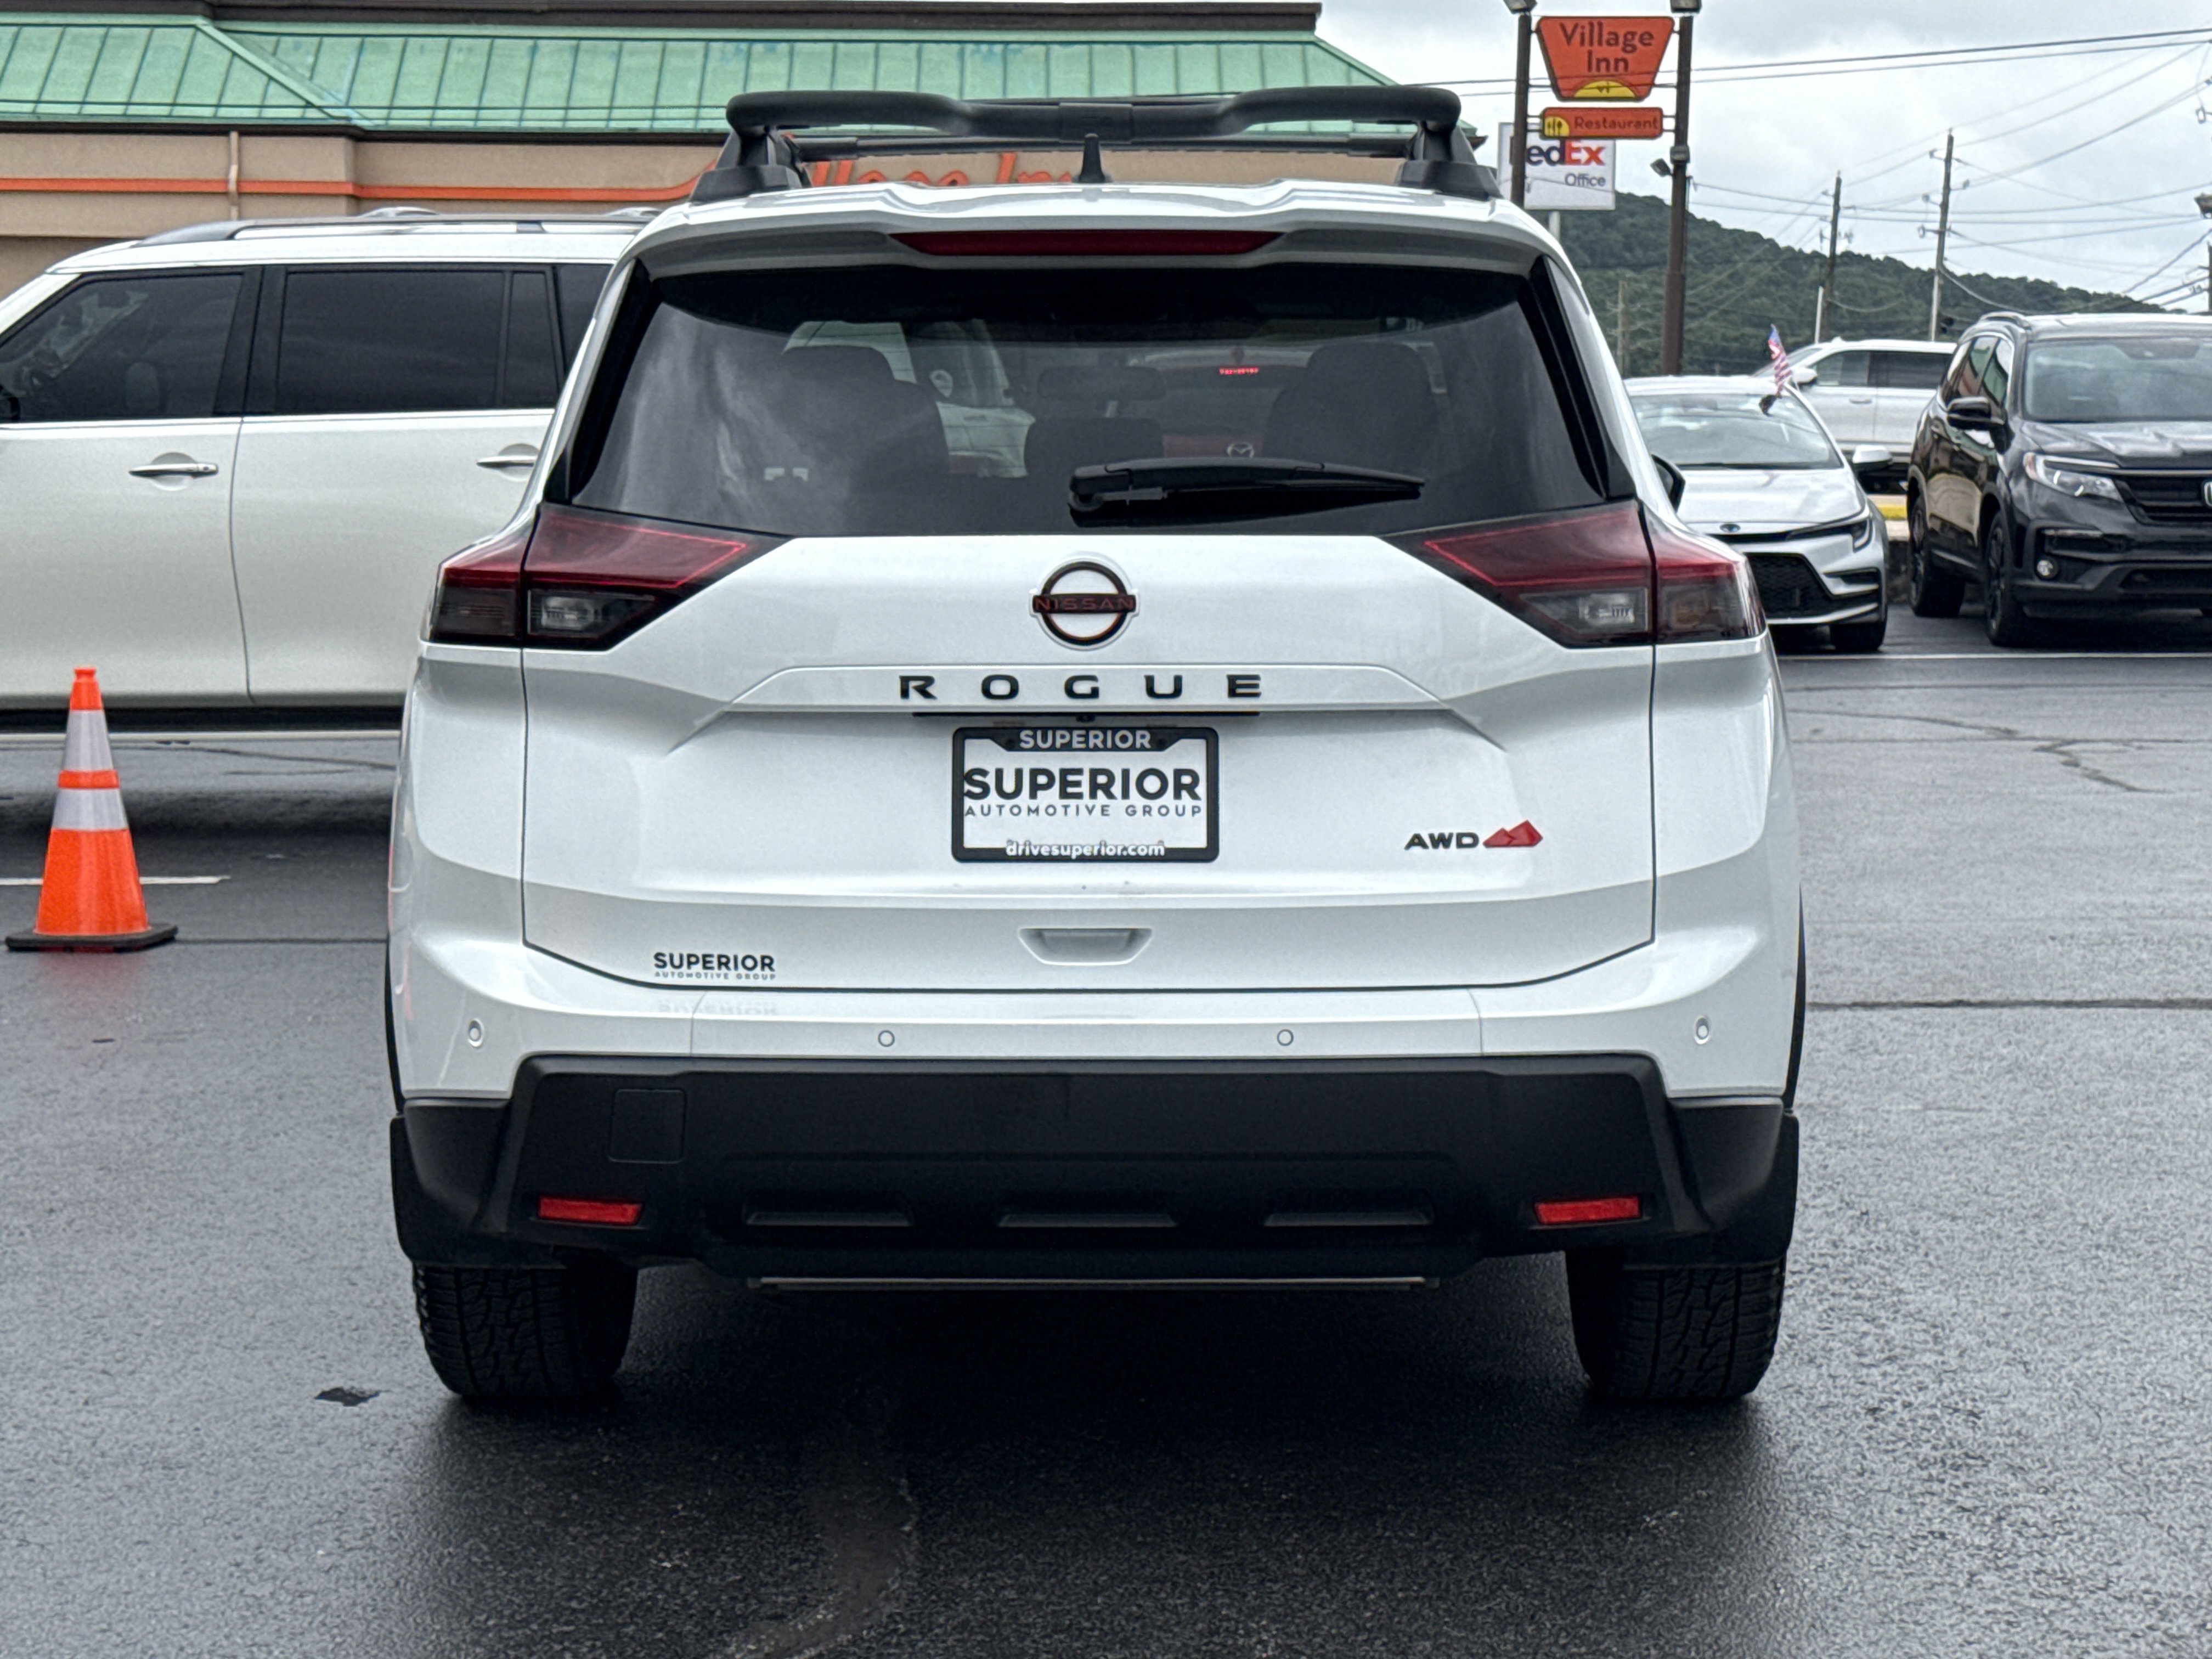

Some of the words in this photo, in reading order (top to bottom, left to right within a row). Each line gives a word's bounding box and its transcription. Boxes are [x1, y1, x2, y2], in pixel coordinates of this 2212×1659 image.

[1560, 21, 1655, 54] Village
[1587, 49, 1629, 73] Inn
[1574, 116, 1658, 130] Restaurant
[1526, 139, 1606, 166] edEx
[1565, 173, 1606, 187] Office
[1034, 597, 1134, 611] NISSAN
[899, 674, 1262, 700] ROGUE
[1019, 730, 1152, 749] SUPERIOR
[964, 768, 1201, 800] SUPERIOR
[964, 805, 1110, 817] AUTOMOTIVE
[1125, 805, 1202, 817] GROUP
[1005, 840, 1165, 859] drivesuperior.com
[1404, 832, 1479, 850] AWD
[653, 952, 775, 972] SUPERIOR
[654, 971, 730, 980] AUTOMOTIVE
